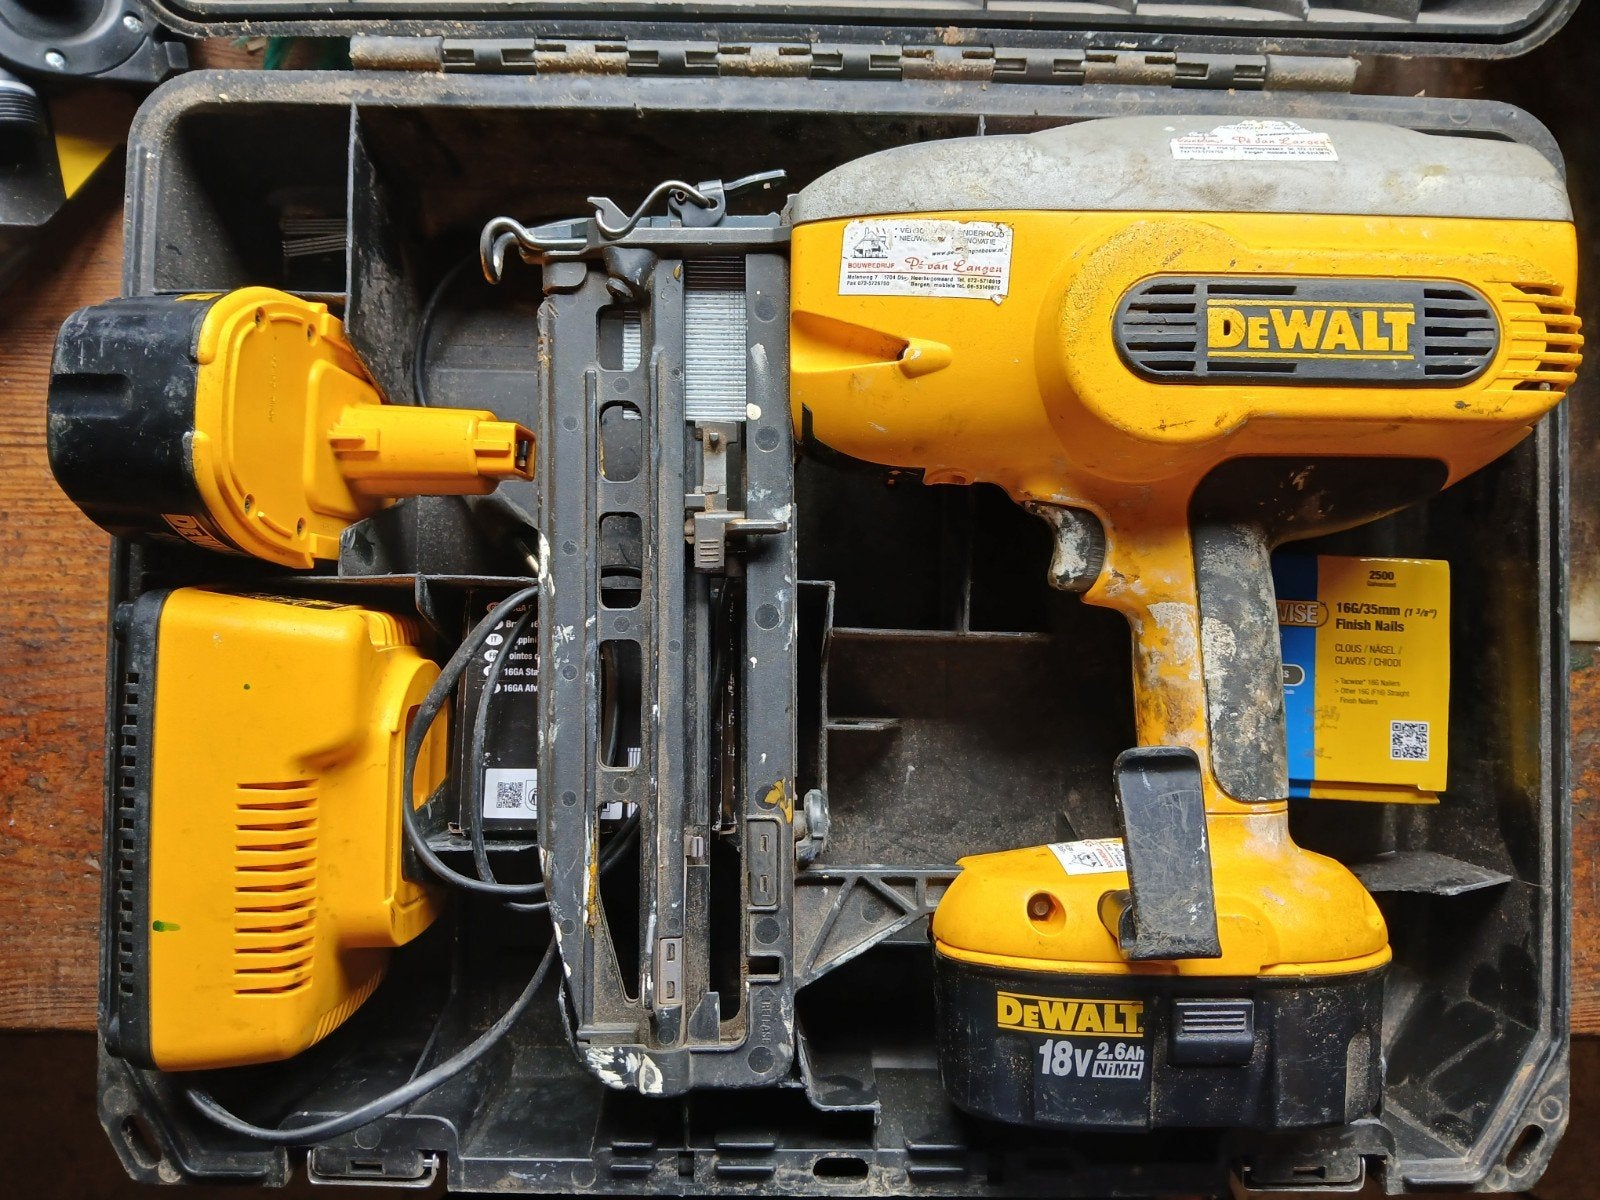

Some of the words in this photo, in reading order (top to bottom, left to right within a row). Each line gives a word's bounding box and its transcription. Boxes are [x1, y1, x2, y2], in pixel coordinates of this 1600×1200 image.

[953, 259, 1002, 275] Langen
[1369, 570, 1395, 580] 2500
[1336, 602, 1401, 616] 16G/35mm
[1335, 618, 1371, 631] Finish
[1375, 620, 1405, 633] Nails
[1335, 643, 1362, 653] CLOUS
[508, 652, 533, 660] ointes
[1335, 656, 1366, 666] CLAVOS
[1374, 657, 1402, 668] CHIODI
[504, 668, 524, 676] 16GA
[525, 668, 539, 676] Sta
[503, 684, 524, 692] 16GA
[1095, 1062, 1144, 1077] NiMH
